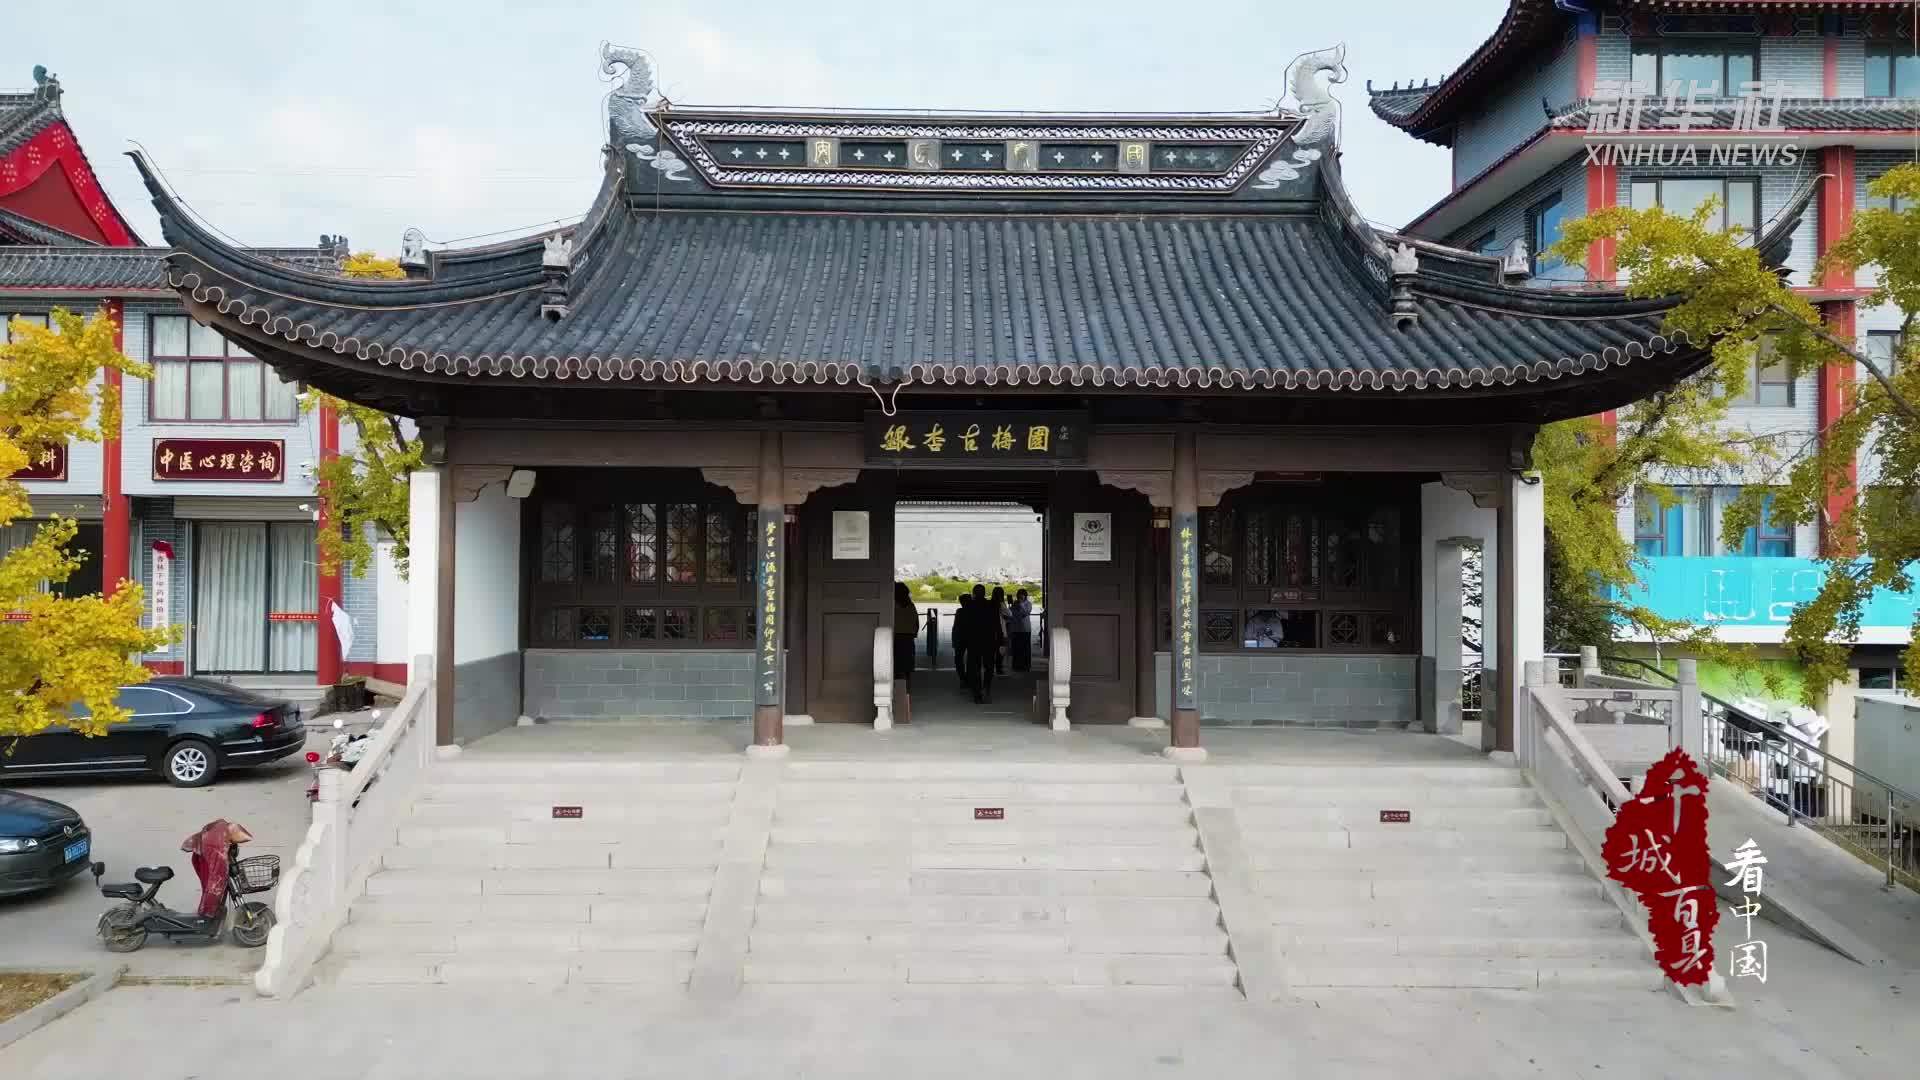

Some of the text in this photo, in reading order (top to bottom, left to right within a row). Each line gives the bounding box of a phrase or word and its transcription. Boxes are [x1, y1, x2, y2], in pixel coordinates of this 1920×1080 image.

[160, 449, 276, 473] 中医心理咨询
